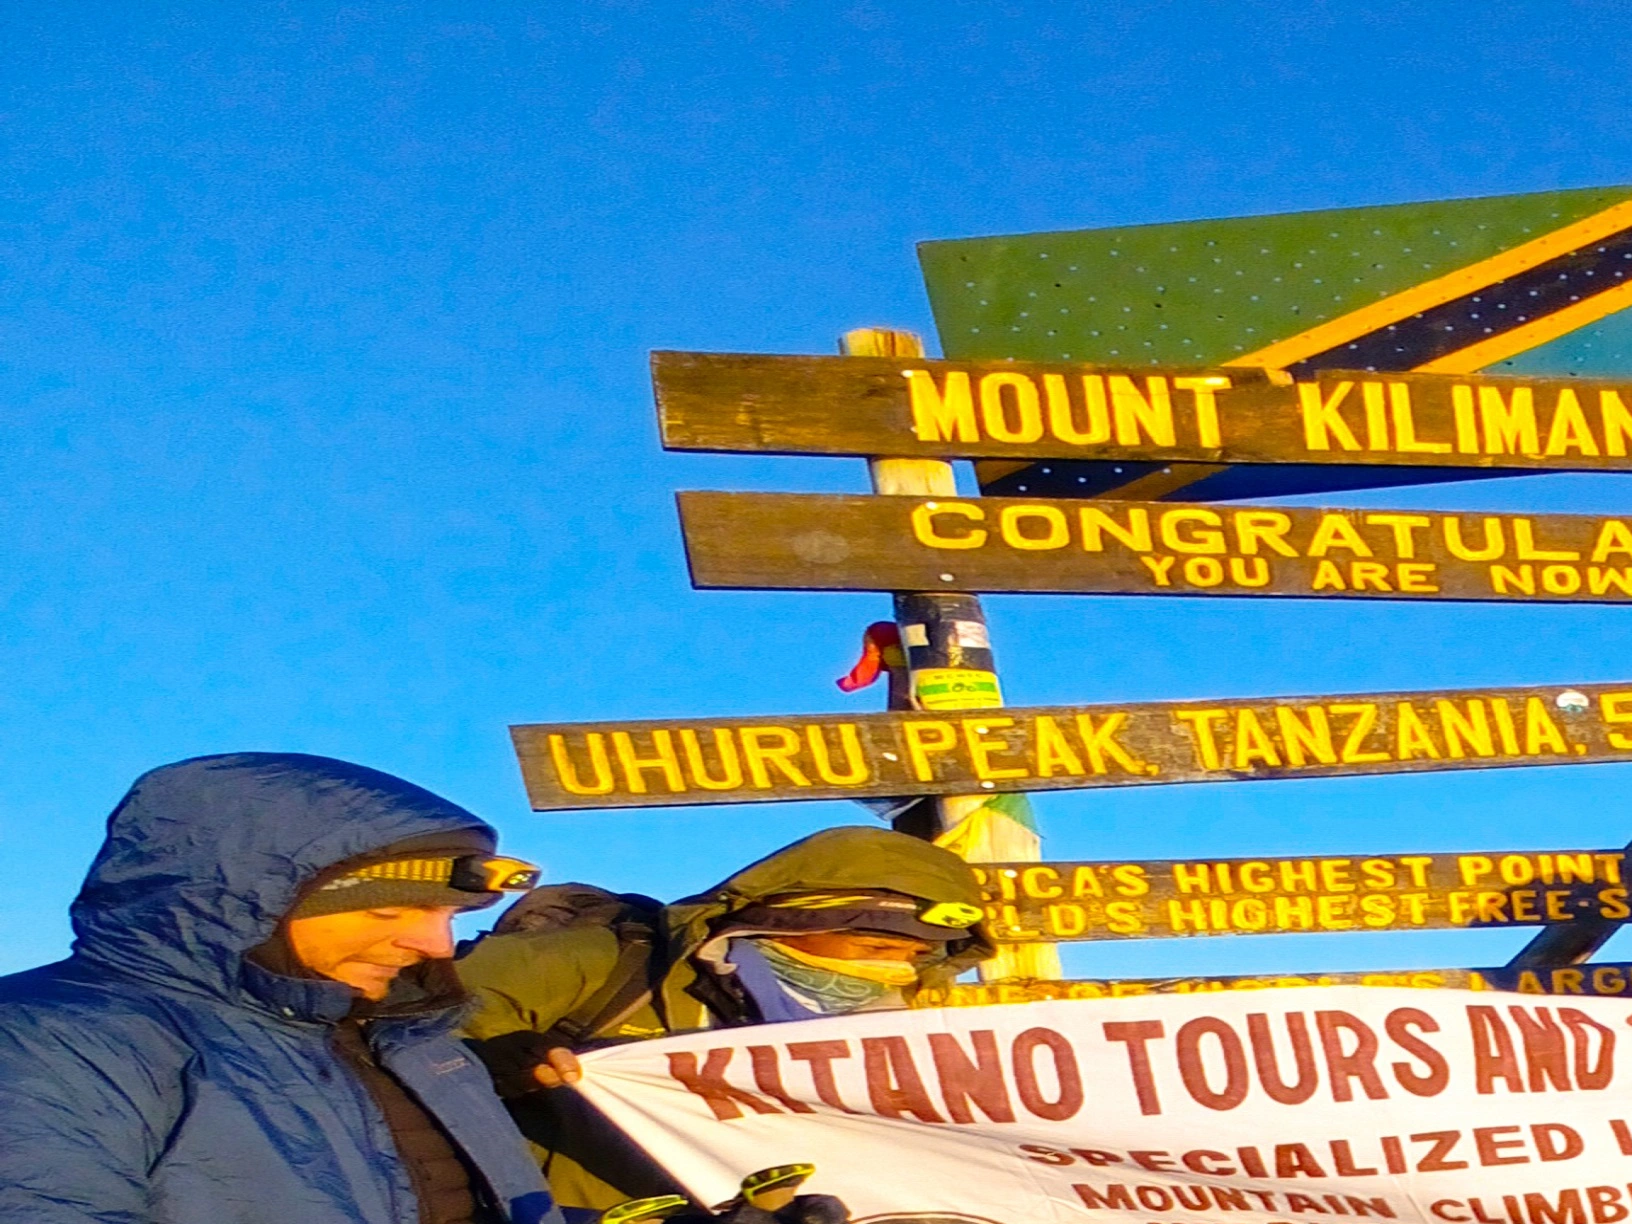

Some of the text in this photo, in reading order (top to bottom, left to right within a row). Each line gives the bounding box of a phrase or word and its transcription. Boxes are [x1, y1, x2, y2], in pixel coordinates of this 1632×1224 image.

[906, 370, 1231, 449] MOUNT
[1142, 556, 1270, 588] YOU
[1313, 562, 1438, 593] ARE
[547, 723, 871, 796] UHURU
[900, 711, 1161, 784] PEAK,
[1176, 697, 1587, 771] TANZANIA,
[1172, 854, 1432, 896] HIGHEST
[1458, 851, 1626, 888] POINT
[1168, 892, 1431, 933] HIGHEST
[666, 1025, 1084, 1124] KITANO
[1103, 1009, 1450, 1116] TOURS
[1471, 1005, 1617, 1094] AND
[1016, 1121, 1583, 1179] SPECIALIZED
[1073, 1183, 1397, 1220] MOUNTAIN
